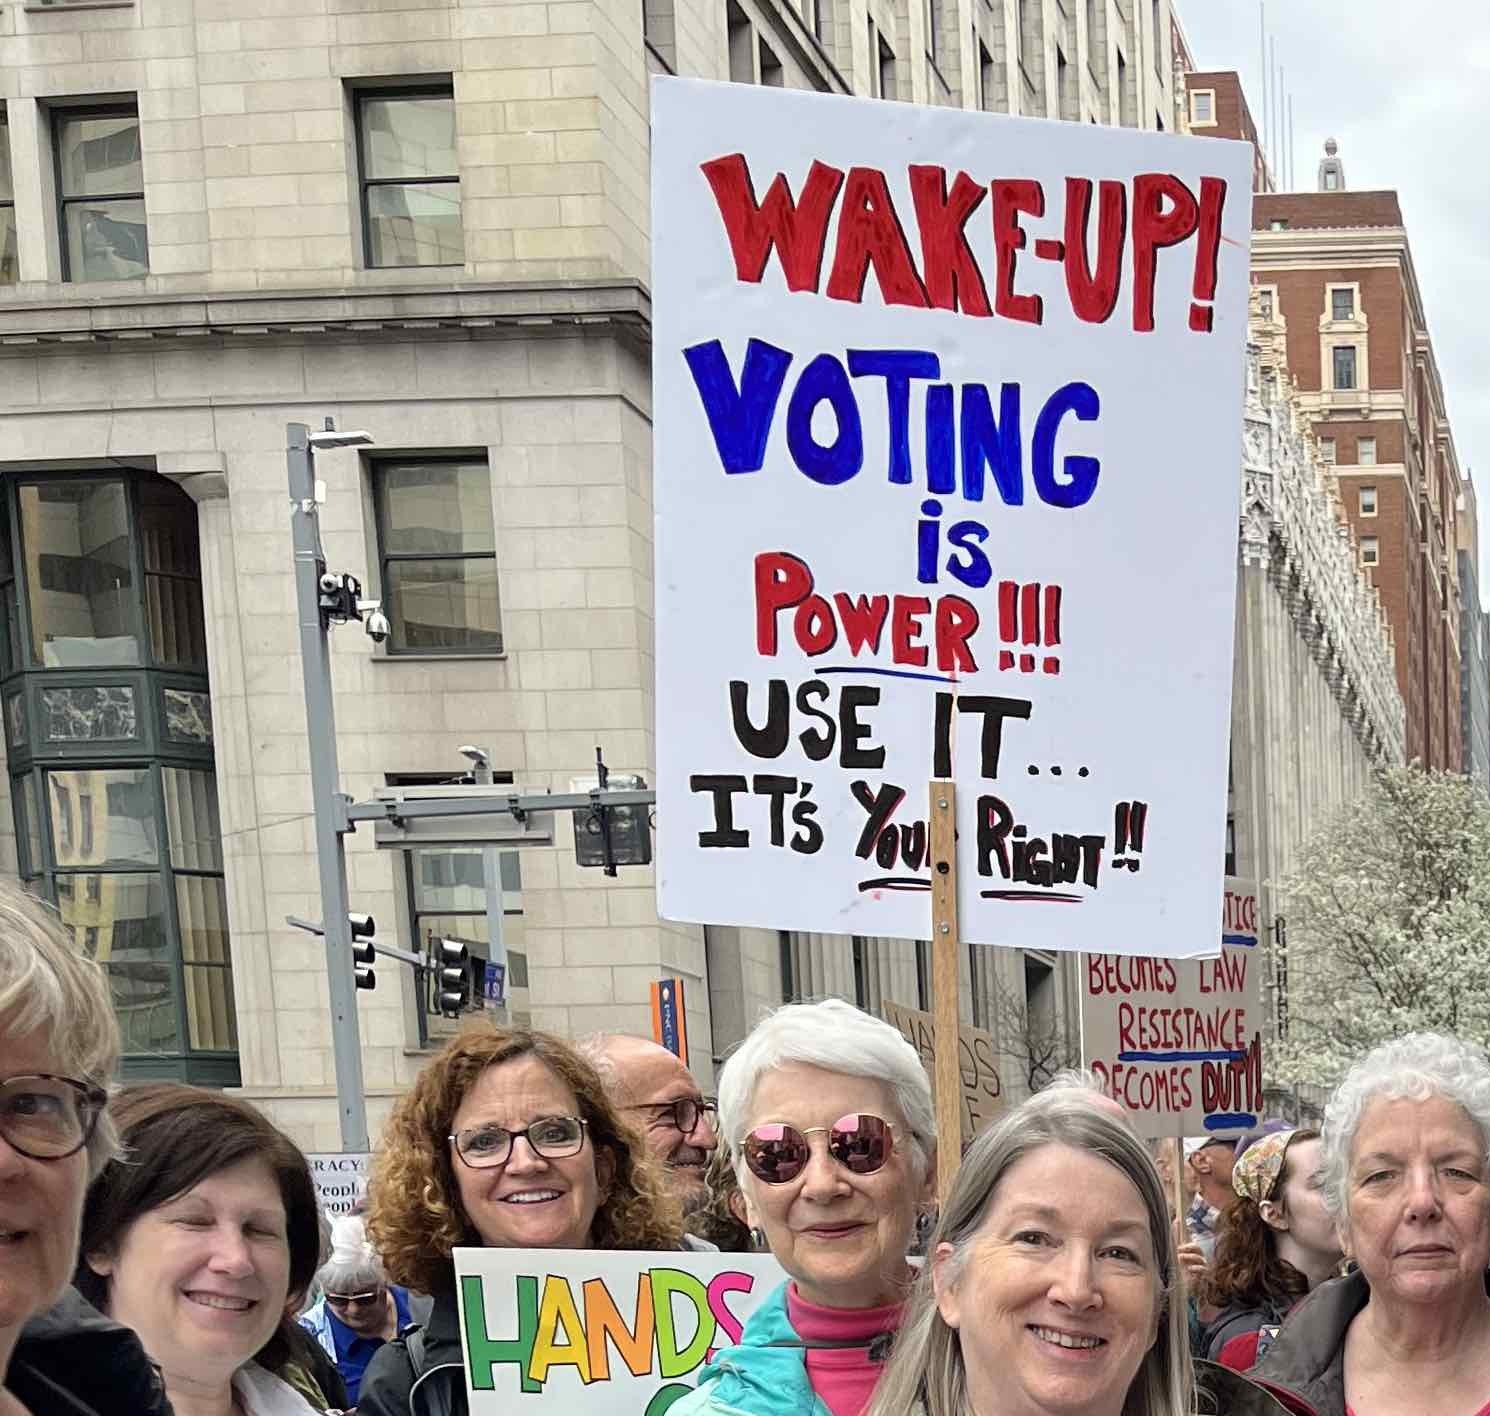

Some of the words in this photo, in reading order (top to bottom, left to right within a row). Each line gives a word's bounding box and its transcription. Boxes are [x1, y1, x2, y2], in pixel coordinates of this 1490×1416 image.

[700, 152, 1227, 333] WAKE-UP!
[682, 338, 1100, 508] VOTING
[730, 679, 886, 769] USE
[1199, 951, 1247, 993] LAW
[1119, 1002, 1245, 1052] RESISTANCE
[460, 1268, 754, 1393] HANDS
